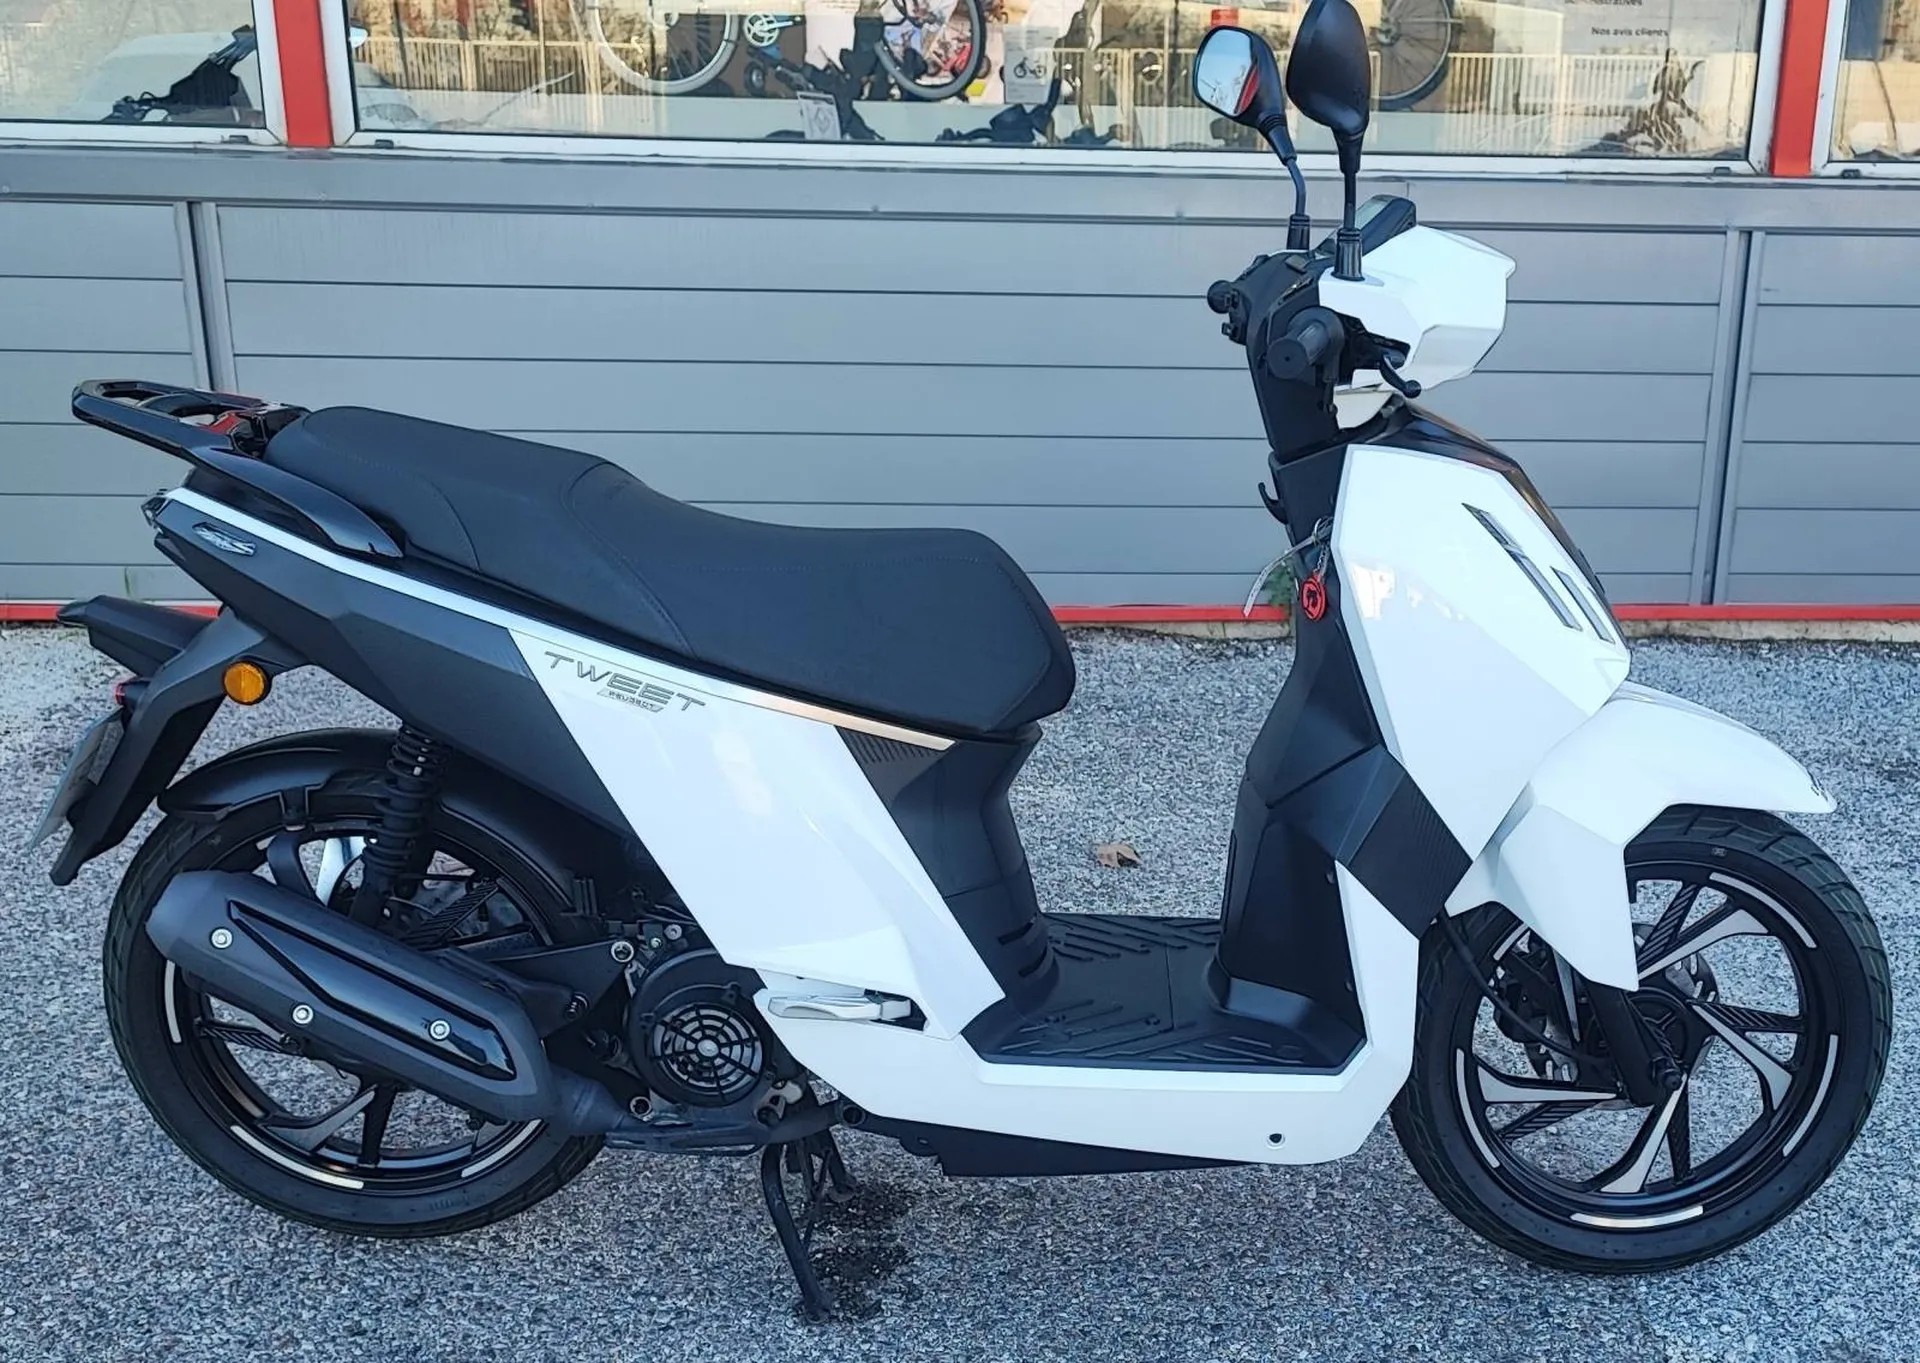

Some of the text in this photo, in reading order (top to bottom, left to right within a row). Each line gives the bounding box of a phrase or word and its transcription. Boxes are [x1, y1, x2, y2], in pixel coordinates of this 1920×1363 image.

[1591, 26, 1669, 37] Nos avis clients
[544, 651, 706, 711] TWEET
